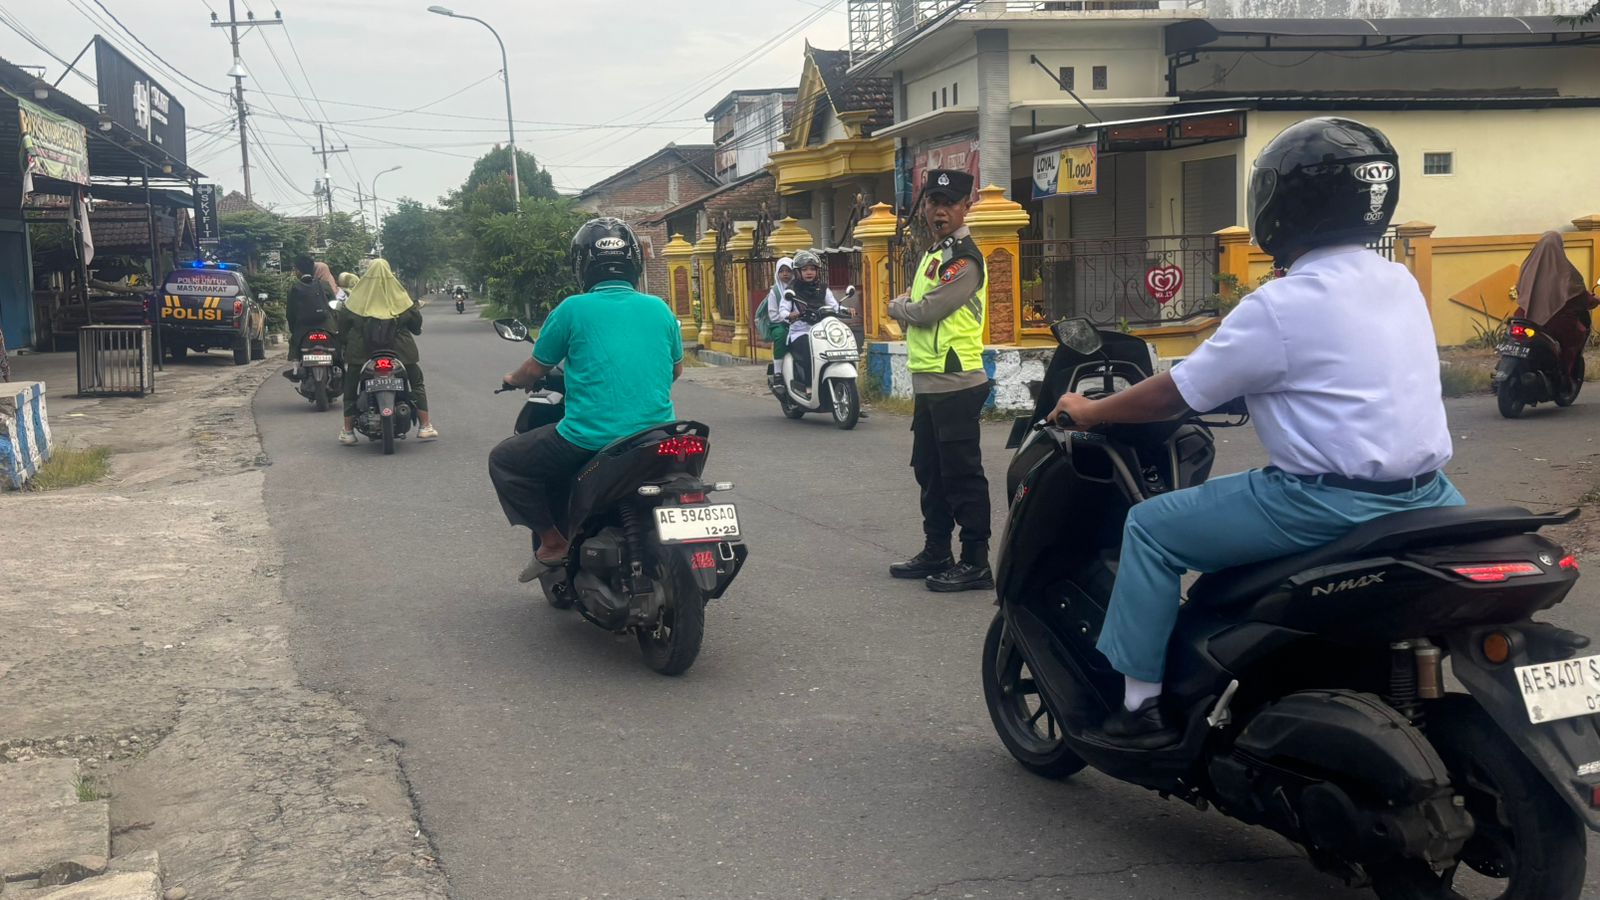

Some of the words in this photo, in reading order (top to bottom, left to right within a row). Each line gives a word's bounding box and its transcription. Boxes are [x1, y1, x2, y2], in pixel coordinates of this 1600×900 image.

[1036, 155, 1055, 172] LOYAL
[1359, 165, 1392, 179] KYT
[200, 194, 212, 237] SKYFIT
[176, 284, 228, 293] MASYARAKAT
[160, 306, 223, 321] POLISI
[659, 510, 677, 524] AE
[1311, 570, 1387, 597] NMAX
